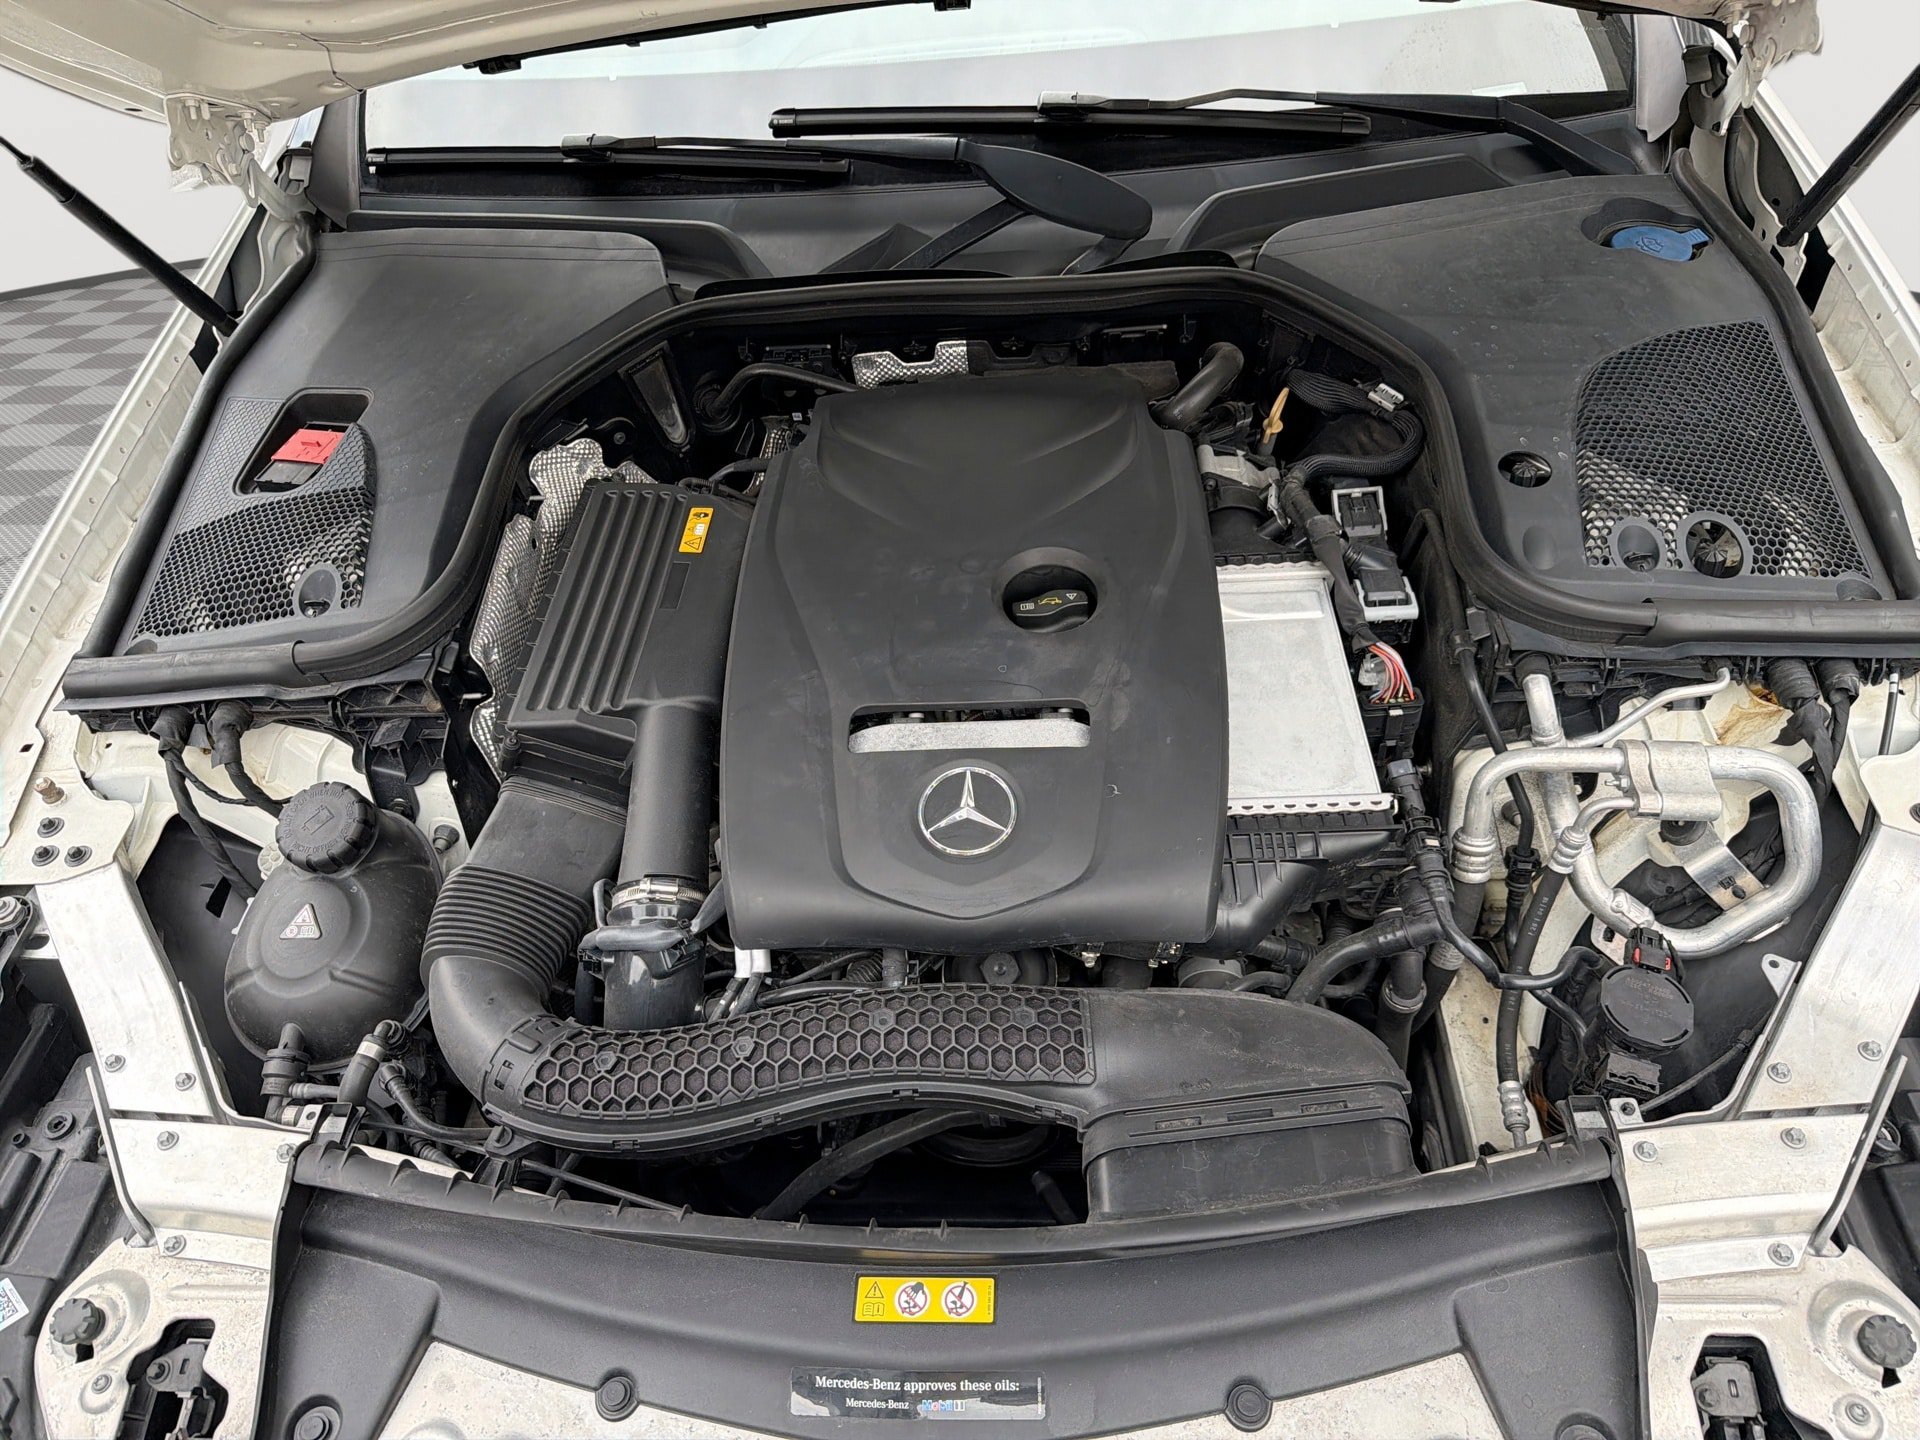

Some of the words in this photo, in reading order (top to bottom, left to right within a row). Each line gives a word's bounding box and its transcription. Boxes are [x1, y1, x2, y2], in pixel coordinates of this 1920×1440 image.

[815, 1375, 901, 1391] Mercedes-Benz
[903, 1381, 957, 1394] approves
[960, 1379, 992, 1391] these
[994, 1379, 1020, 1392] oils:
[845, 1397, 910, 1410] Mercedes-Benz
[921, 1399, 954, 1412] Mobil
